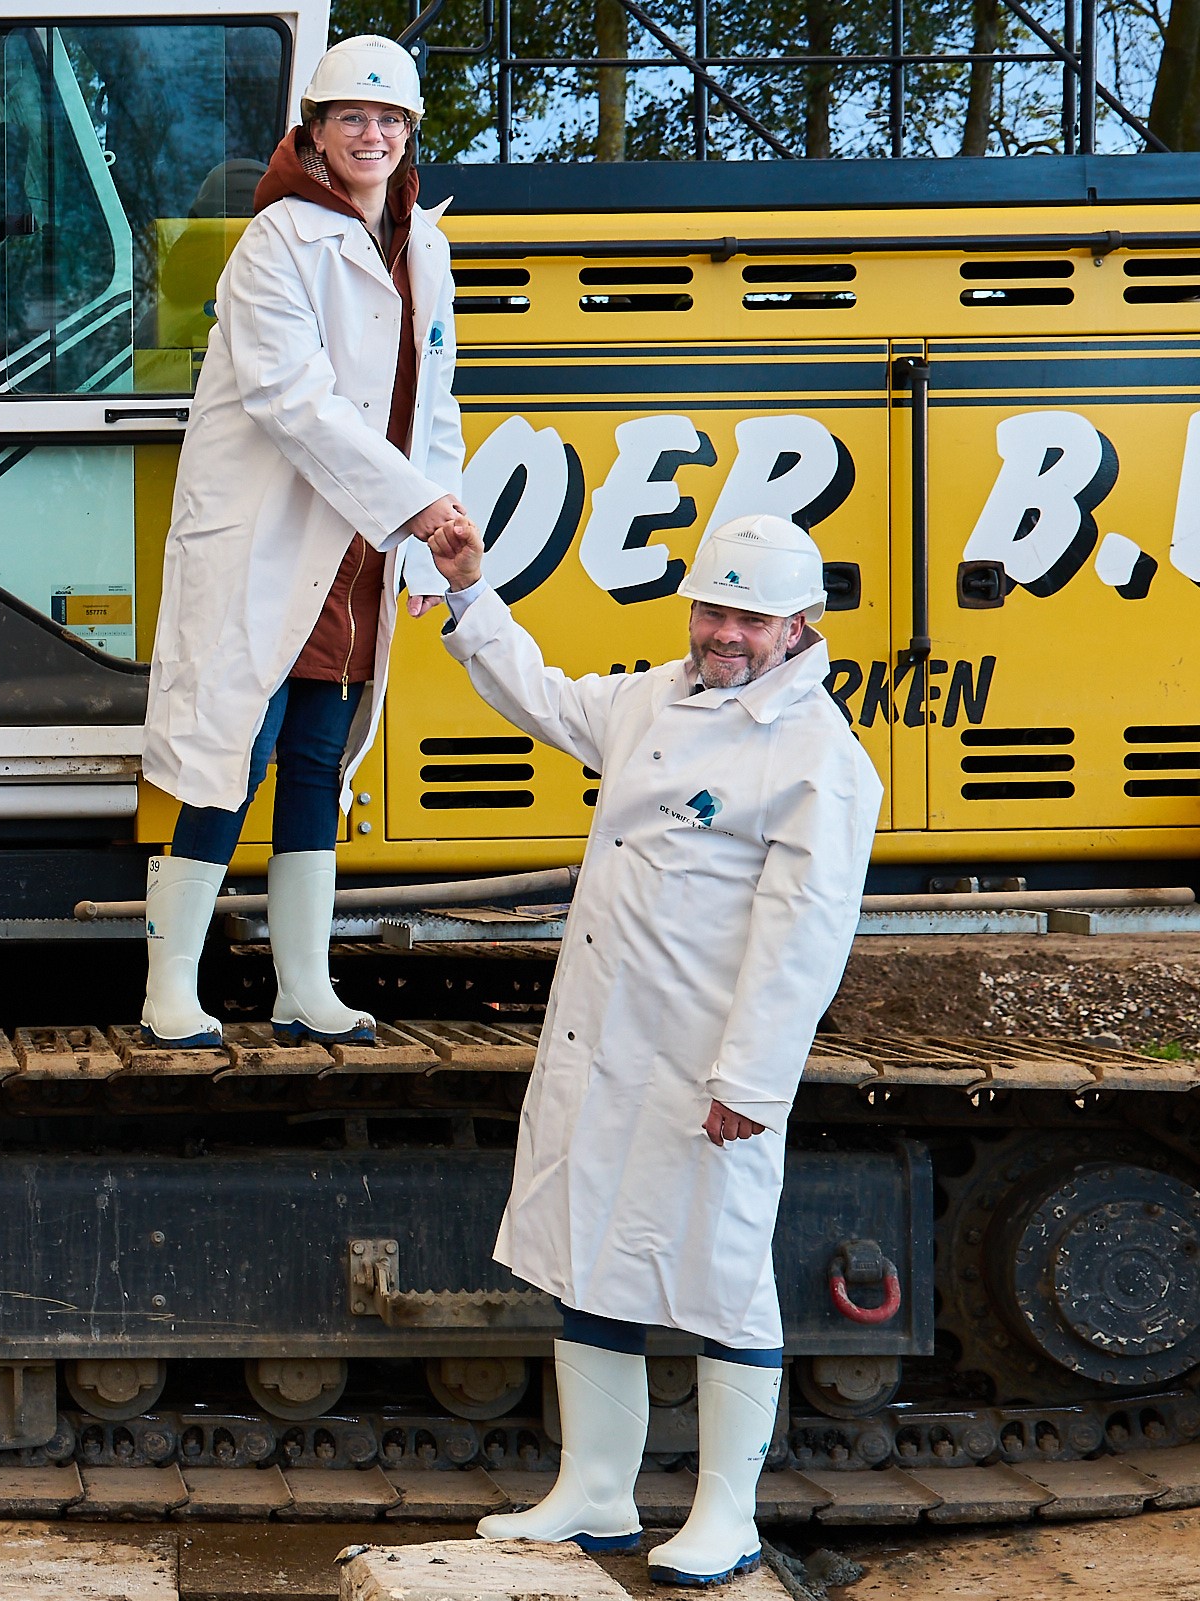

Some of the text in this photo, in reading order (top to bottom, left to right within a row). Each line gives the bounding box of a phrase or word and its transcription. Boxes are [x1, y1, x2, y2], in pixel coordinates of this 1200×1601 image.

[963, 410, 1200, 599] B.
[659, 805, 669, 815] DE
[149, 860, 160, 872] 39
